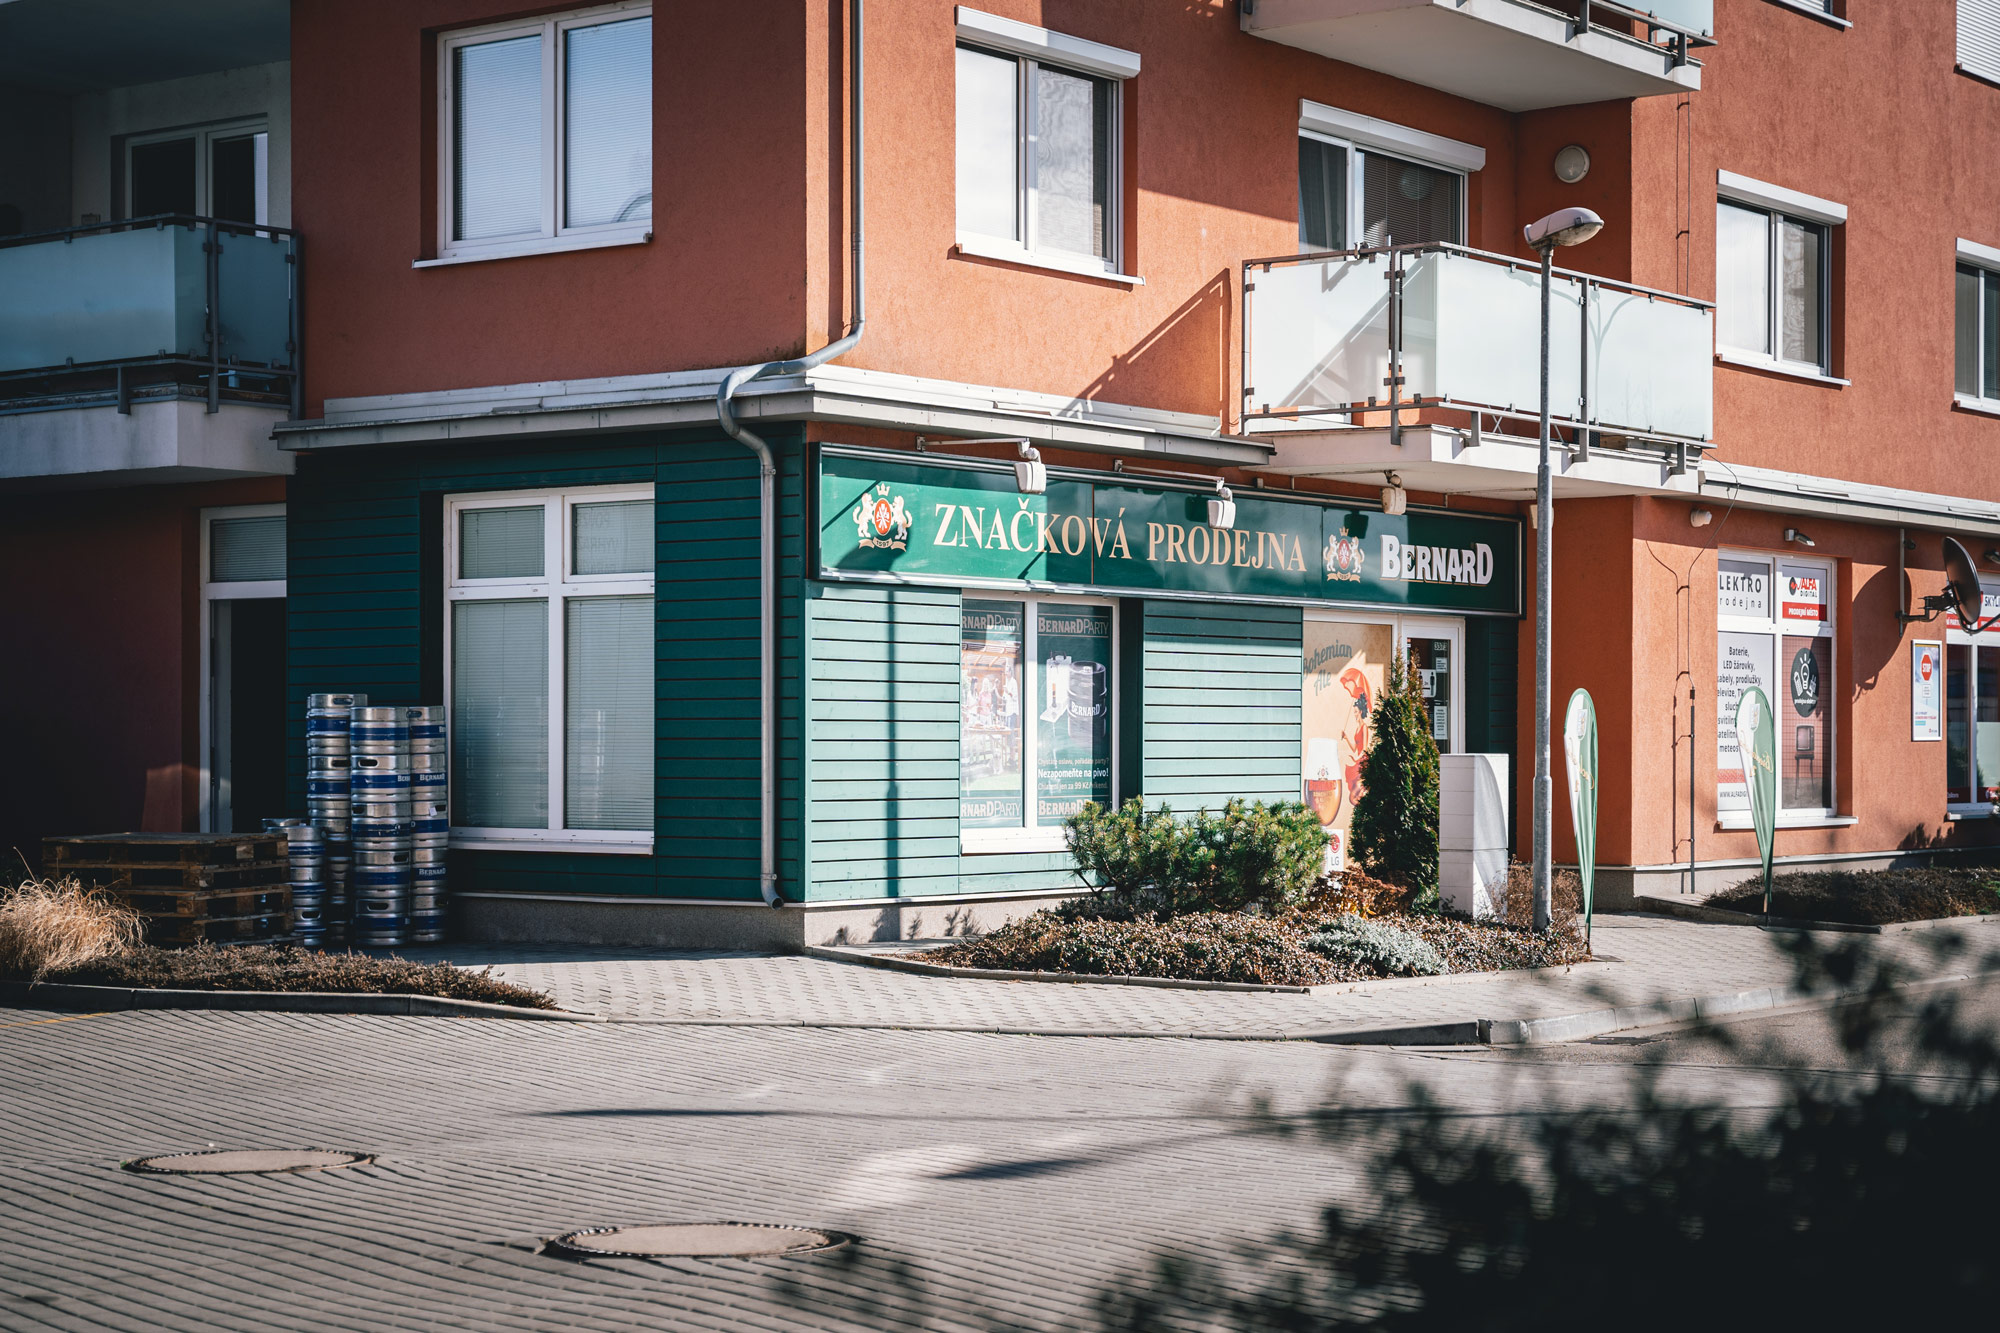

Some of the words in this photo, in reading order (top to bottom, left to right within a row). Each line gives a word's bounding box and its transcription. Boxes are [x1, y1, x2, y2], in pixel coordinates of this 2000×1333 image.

[933, 497, 1132, 560] ZNAČKOVÁ
[1146, 520, 1308, 572] PRODEJNA
[1380, 534, 1494, 587] BERNARD
[1719, 574, 1762, 593] LEKTRO
[1719, 596, 1762, 610] rodejna
[961, 614, 1021, 632] RNARDPARTY
[1728, 646, 1750, 658] Baterie,
[1723, 660, 1733, 670] LED
[1922, 663, 1932, 673] STOP
[1313, 669, 1332, 697] Ale
[1717, 687, 1736, 699] elevize,
[1071, 701, 1101, 717] BERNARD
[1719, 744, 1740, 753] meteos
[1037, 767, 1083, 780] Nezapomeňte
[1083, 769, 1092, 778] na
[1092, 767, 1109, 780] pivo!
[960, 800, 1021, 818] RNARDPARTY
[1330, 856, 1340, 866] LG
